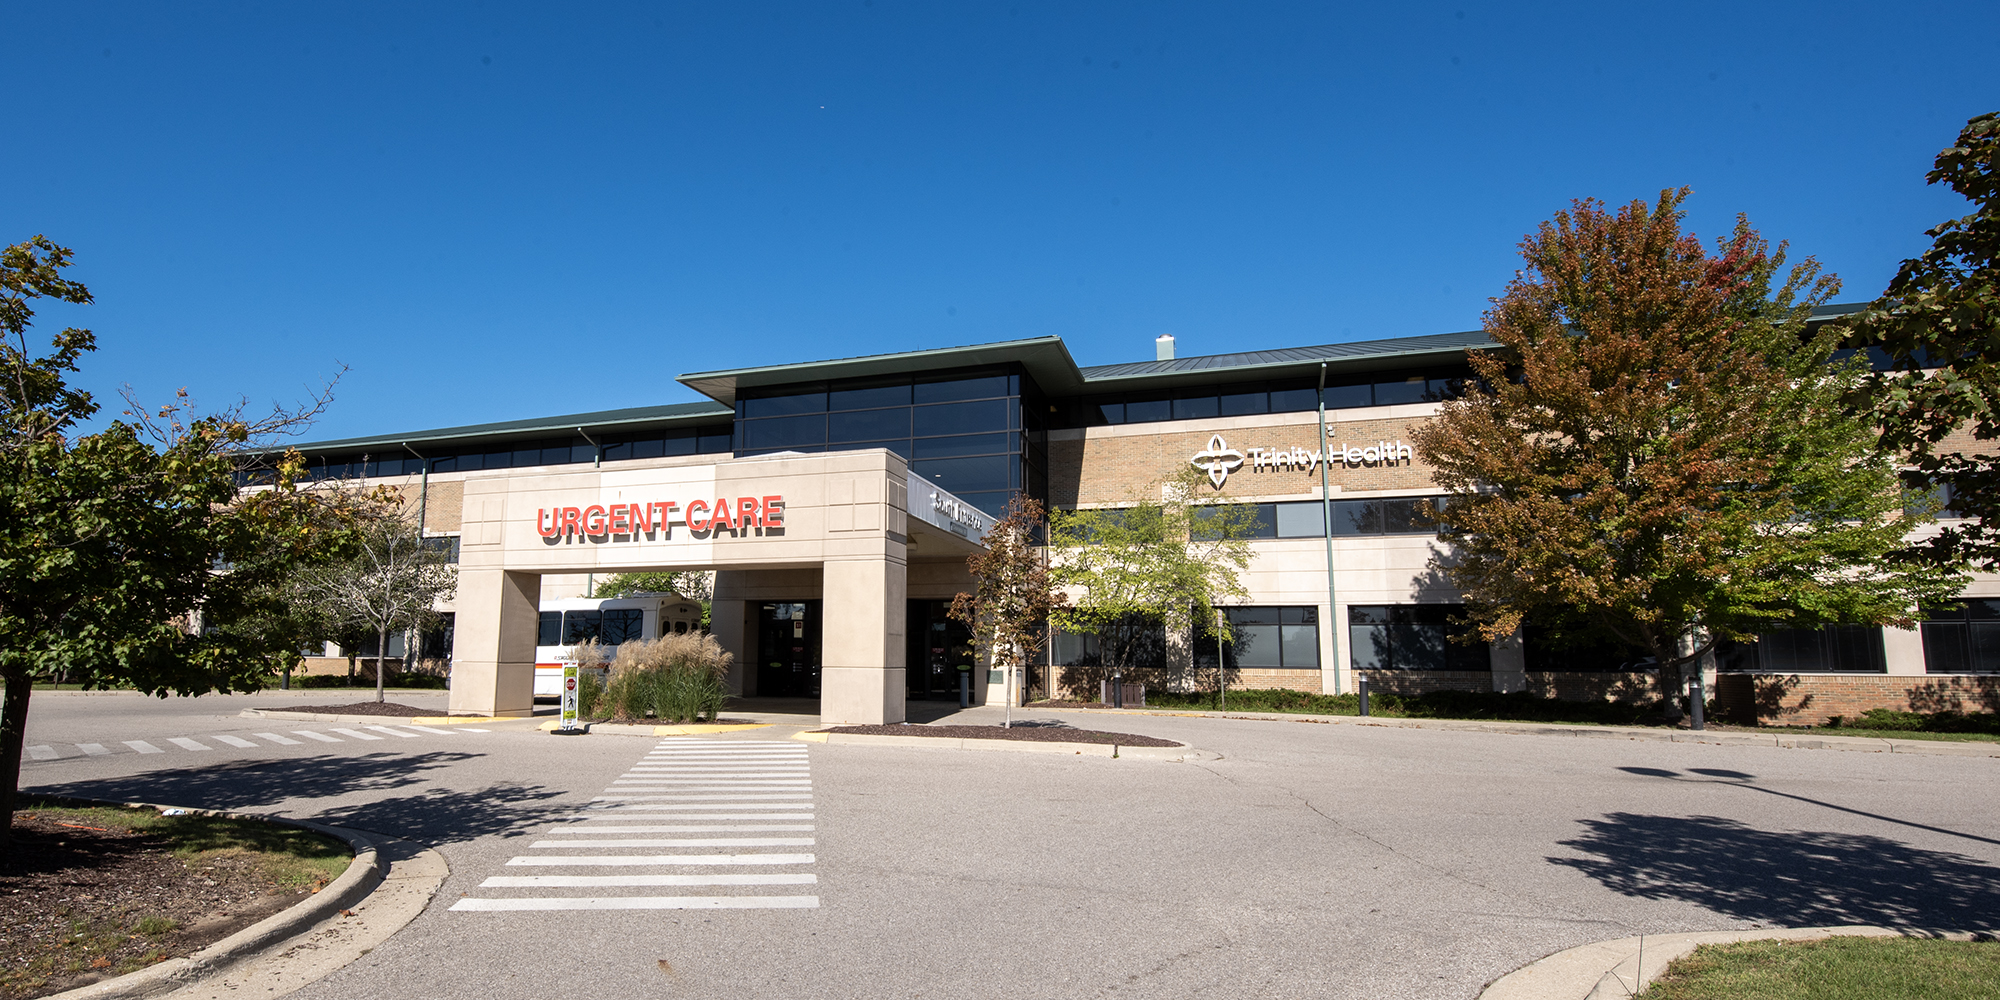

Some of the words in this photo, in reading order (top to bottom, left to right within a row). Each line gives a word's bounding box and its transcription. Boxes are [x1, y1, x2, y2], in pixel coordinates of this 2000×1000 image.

[1248, 446, 1321, 470] Trinity
[1328, 440, 1412, 463] Health
[537, 501, 676, 537] URGENT
[685, 495, 782, 531] CARE
